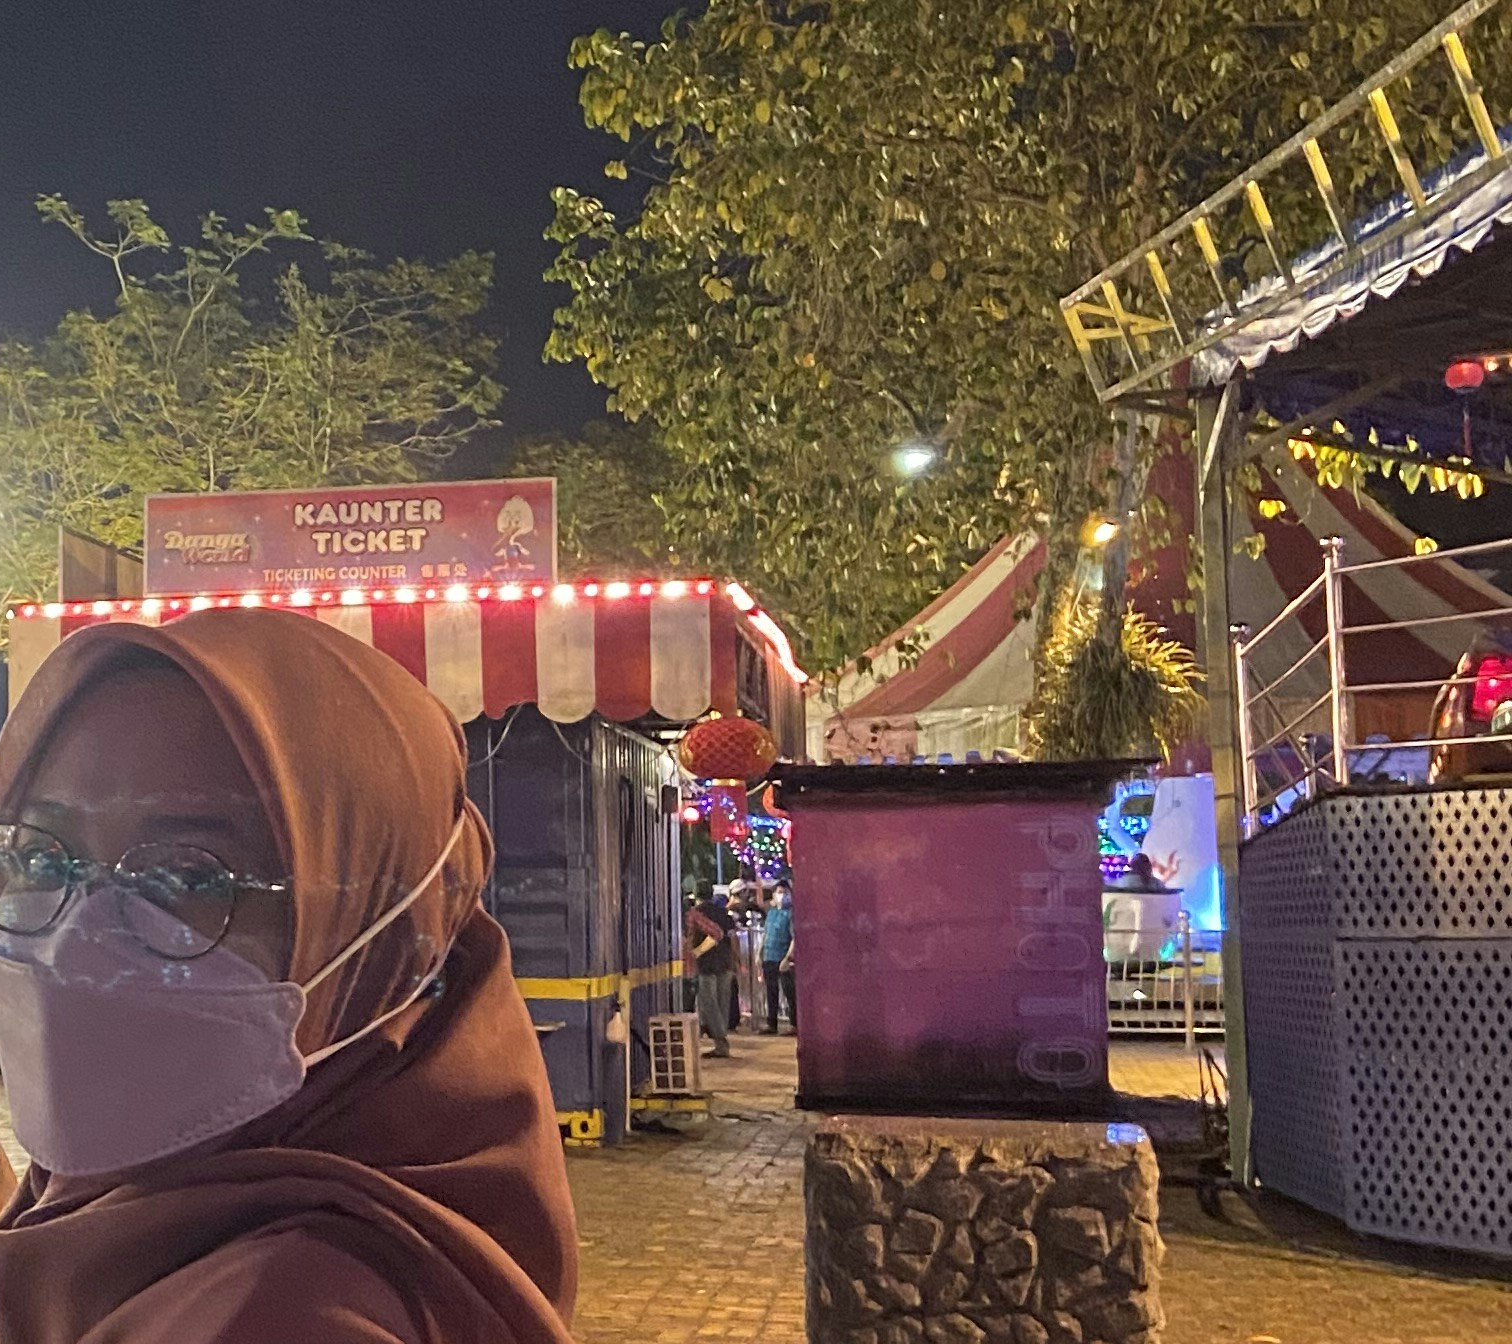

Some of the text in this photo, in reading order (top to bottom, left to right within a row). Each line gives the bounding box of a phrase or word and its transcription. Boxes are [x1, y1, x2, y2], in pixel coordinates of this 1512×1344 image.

[293, 496, 444, 527] KAUNTER
[311, 526, 428, 555] TICKET
[263, 564, 407, 583] TICKETING COUNTER
[1012, 815, 1100, 1089] PHOTO
